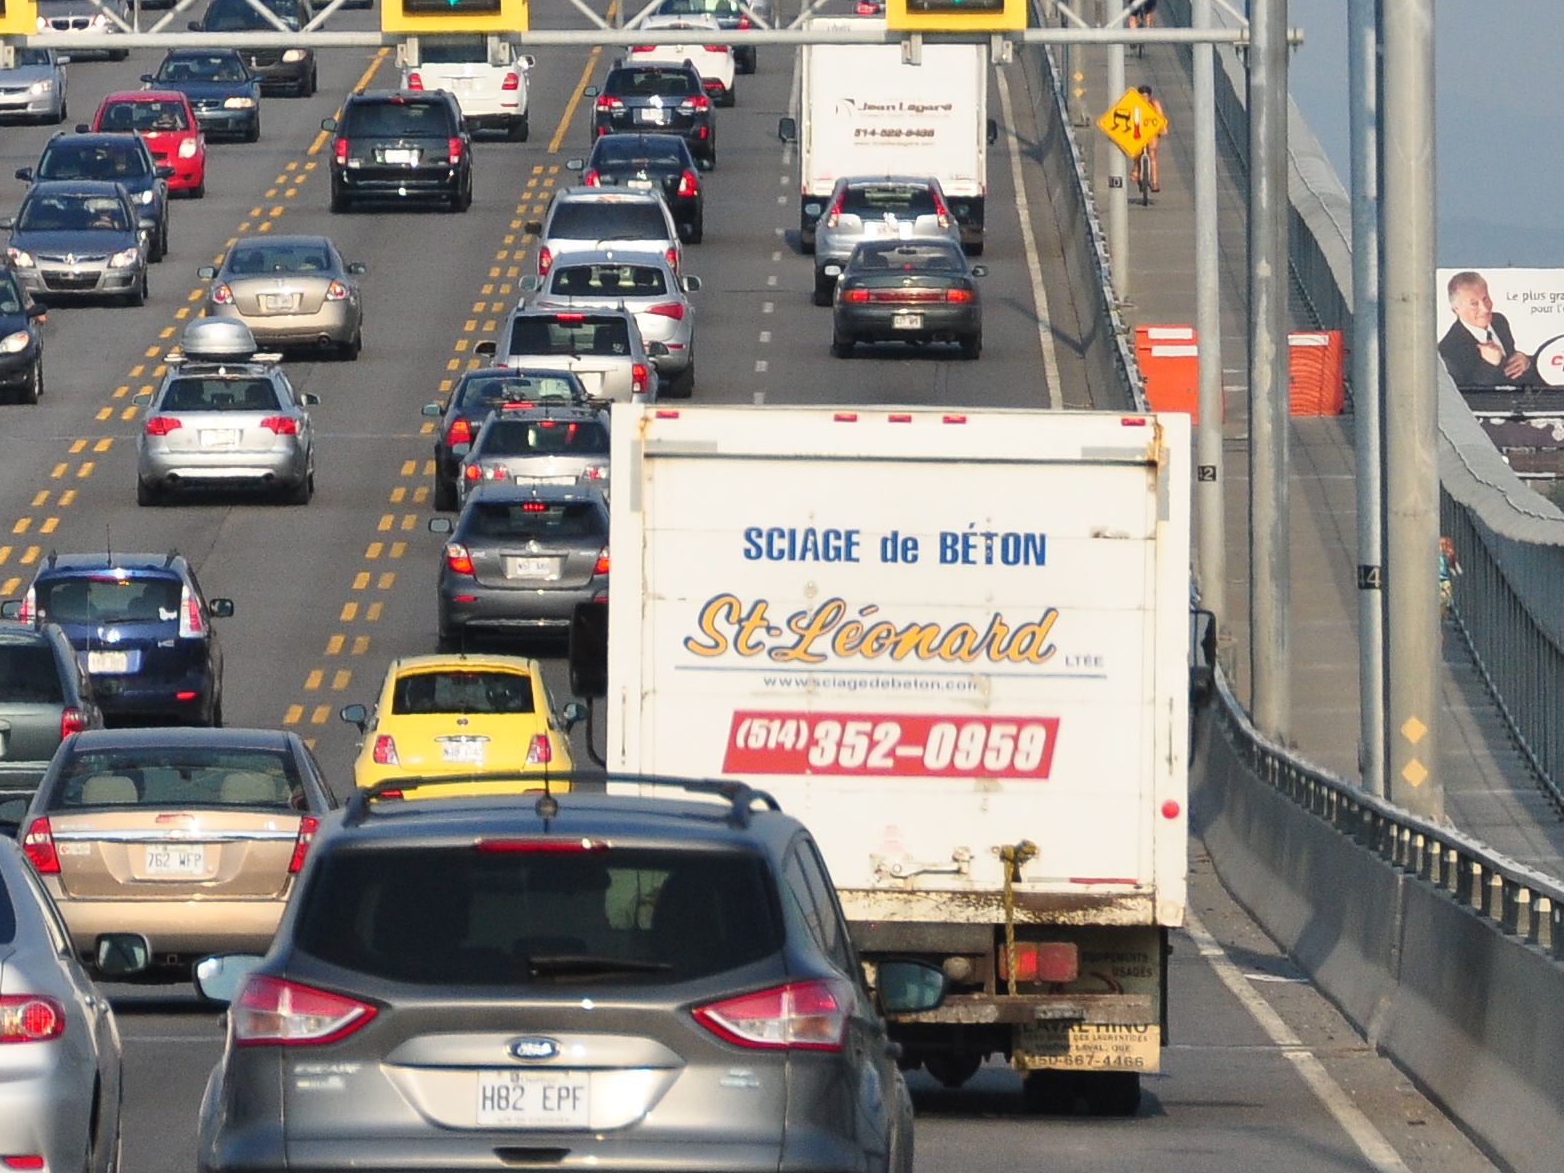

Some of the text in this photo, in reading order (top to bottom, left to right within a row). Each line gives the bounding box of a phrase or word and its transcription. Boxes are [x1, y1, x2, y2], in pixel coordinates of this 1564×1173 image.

[1506, 290, 1564, 304] Le plus gra
[1531, 305, 1554, 315] pour
[743, 522, 1047, 567] SCIAGE de BÉTON
[683, 593, 1105, 669] St-Léonard LTÉE
[735, 718, 1047, 771] (514) 352-0959
[148, 853, 202, 868] 762 WFP
[481, 1085, 586, 1111] H82 EPF
